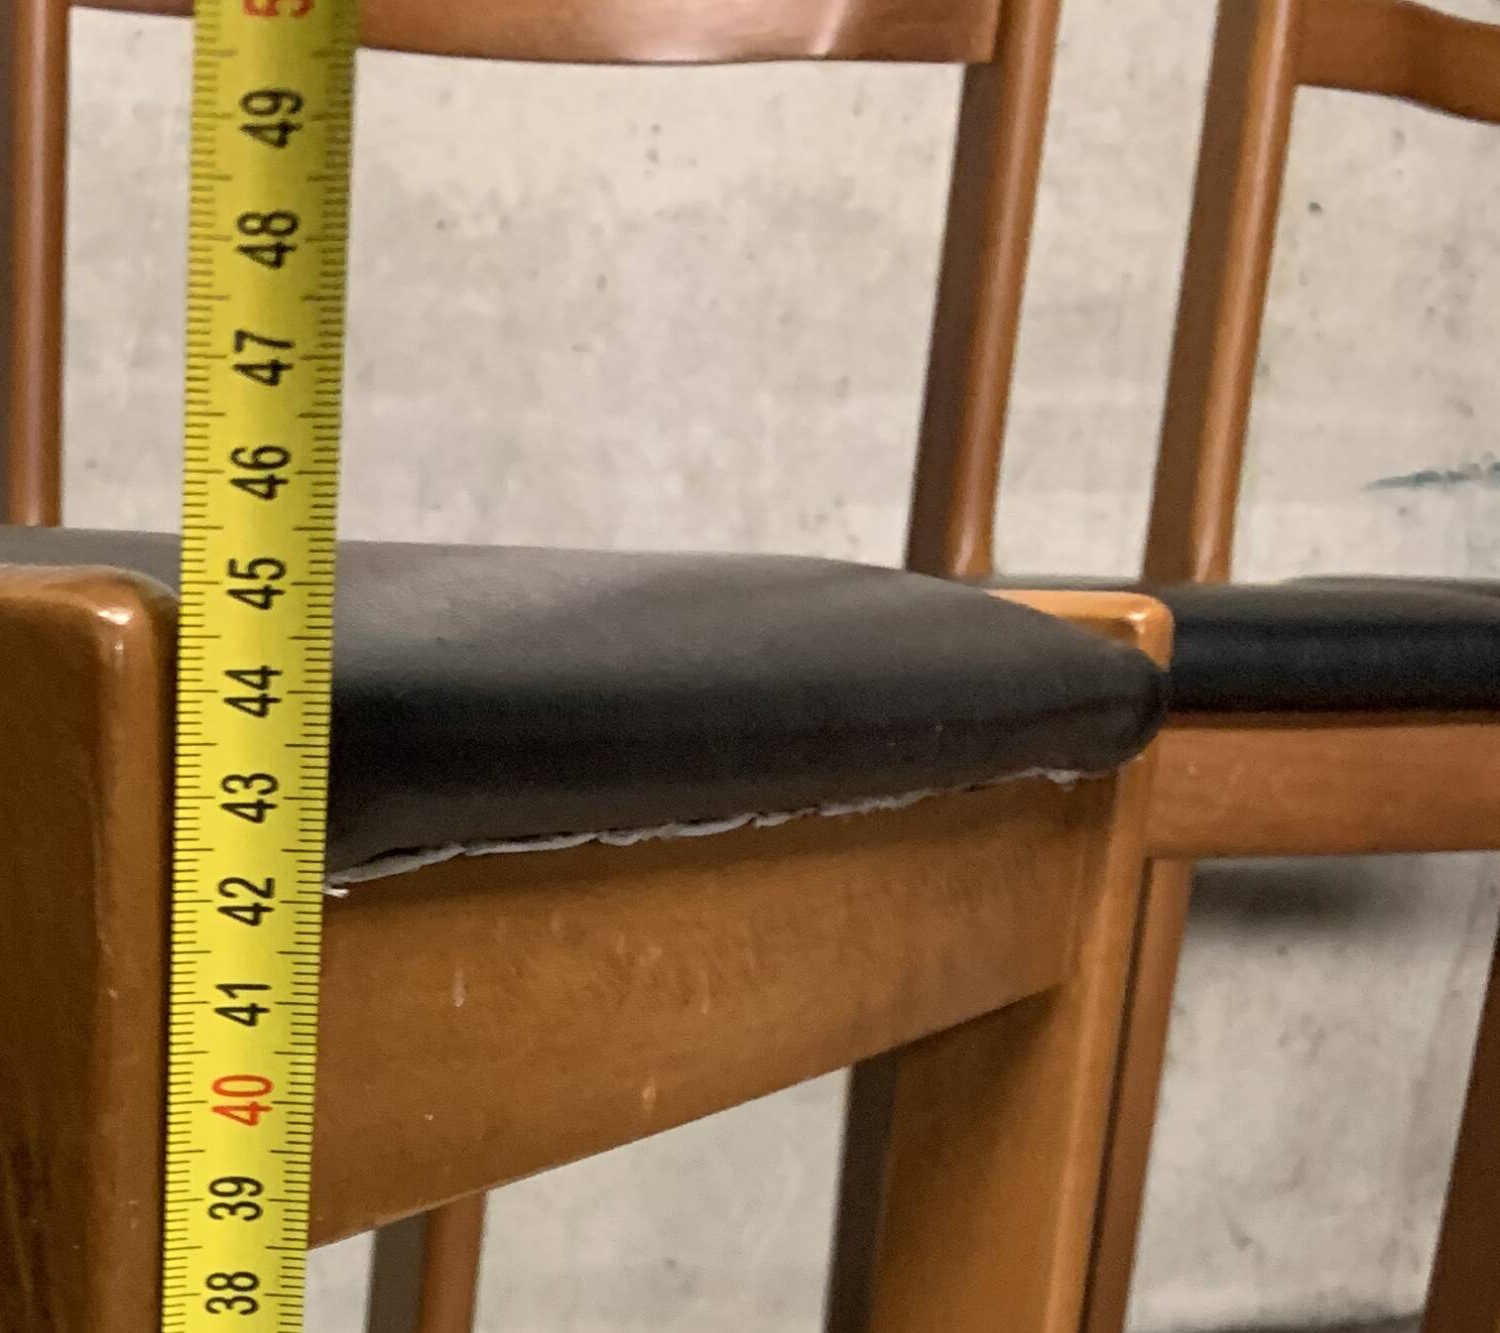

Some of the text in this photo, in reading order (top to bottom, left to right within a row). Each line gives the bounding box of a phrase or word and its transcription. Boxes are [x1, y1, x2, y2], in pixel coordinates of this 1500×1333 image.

[239, 87, 309, 150] 49
[236, 209, 302, 271] 48
[232, 329, 297, 388] 47
[229, 444, 293, 502] 46
[226, 557, 288, 611] 45
[223, 664, 284, 719] 44
[220, 772, 280, 825] 43
[216, 876, 276, 927] 42
[214, 983, 273, 1028] 41
[211, 1074, 274, 1127] 40
[207, 1175, 265, 1222] 39
[204, 1271, 261, 1316] 38
